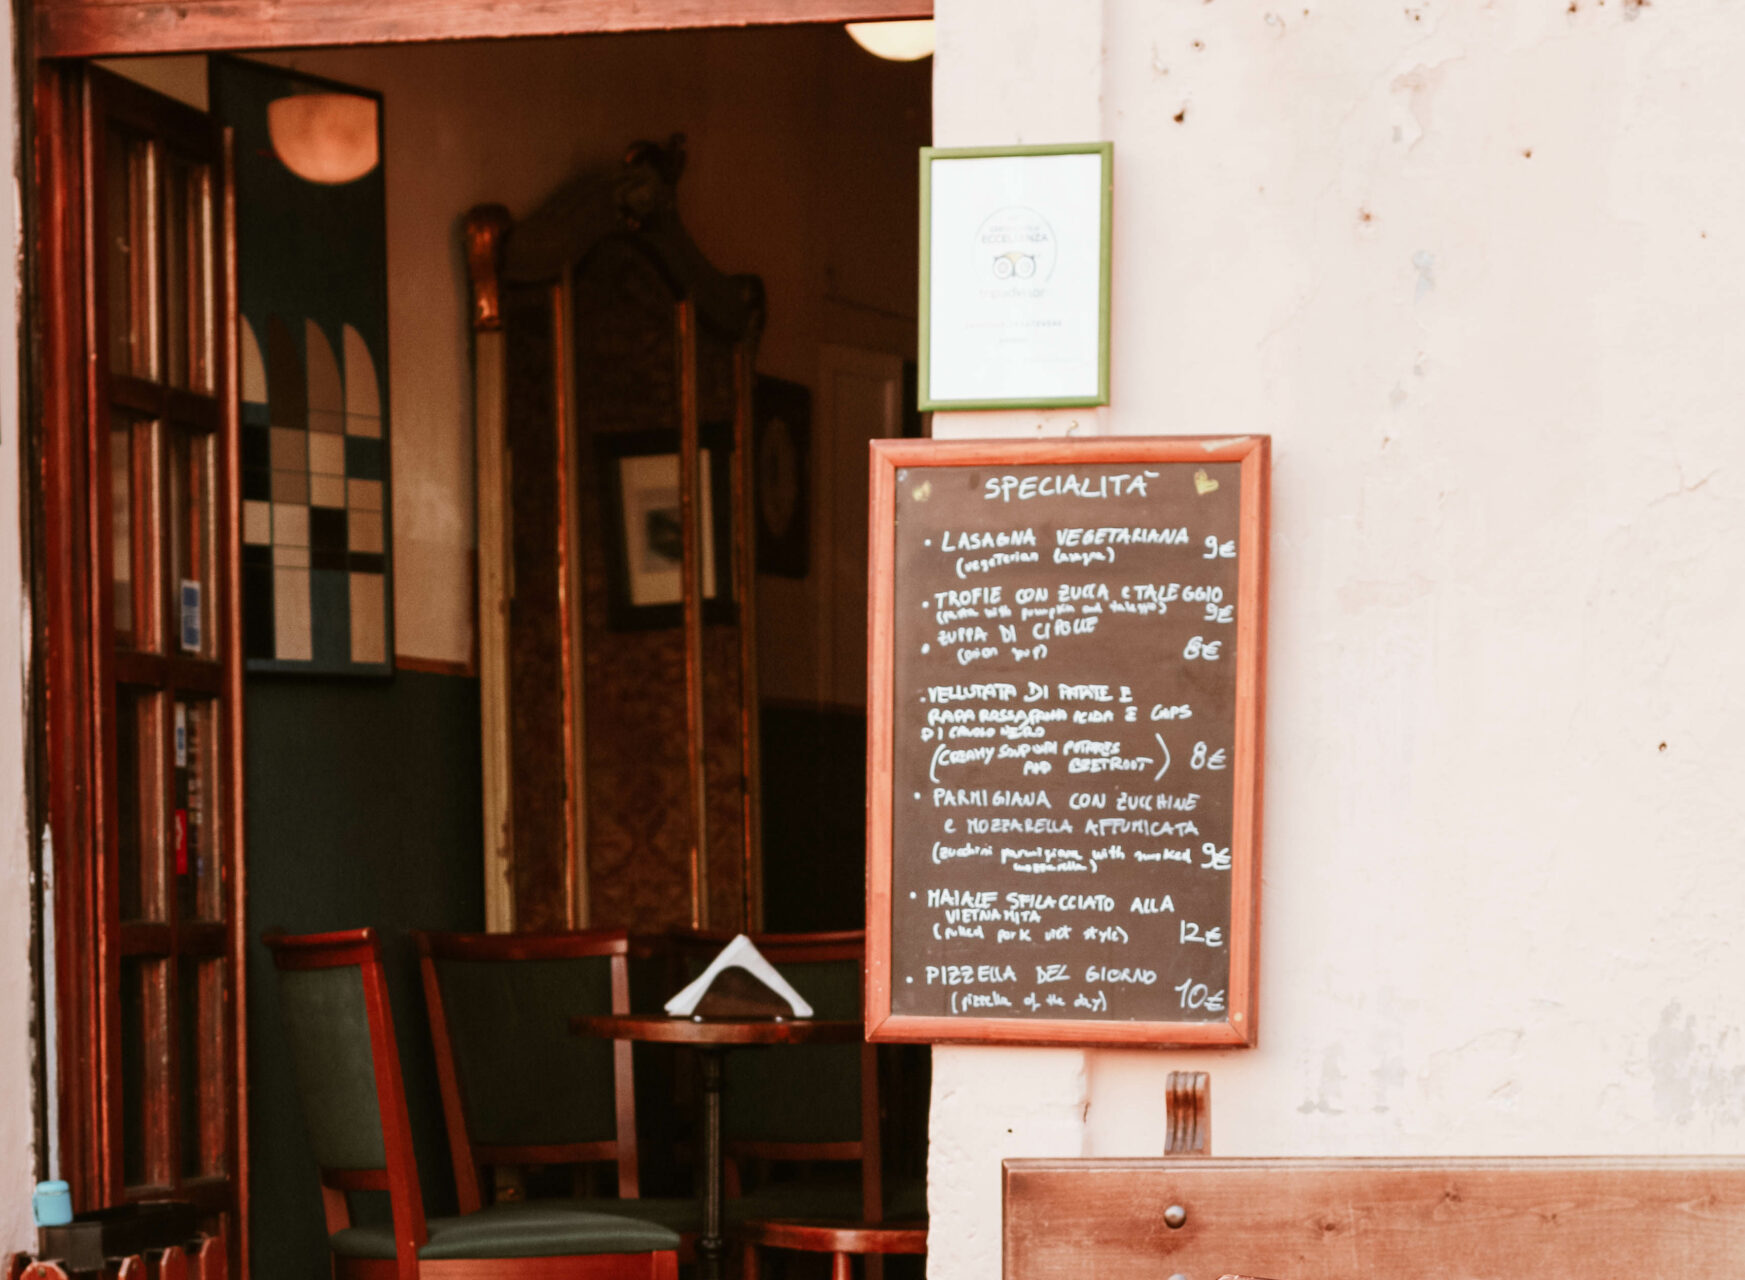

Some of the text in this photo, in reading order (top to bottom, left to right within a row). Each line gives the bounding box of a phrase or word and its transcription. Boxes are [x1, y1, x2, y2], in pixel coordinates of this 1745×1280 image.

[941, 527, 1236, 559] LASAGNA VEGETARIANA 9€
[934, 586, 1002, 609] TROFIE
[1015, 588, 1048, 604] CON
[1058, 583, 1109, 602] ZUCCA
[1204, 604, 1234, 623] 9€
[937, 628, 988, 647] ZUPPA
[998, 624, 1017, 643] DI
[928, 683, 1017, 703] VELLUTATA
[1023, 681, 1049, 703] DI
[1058, 683, 1113, 702] PATATE
[927, 708, 975, 726] RAPA
[1190, 741, 1227, 770] 8€
[932, 788, 1200, 812] PARMIGIANA CON ZUCCHINE
[966, 817, 1073, 835] MOZZARELLA
[1084, 818, 1199, 836] AFFUMICATA
[1091, 845, 1126, 860] with
[1200, 842, 1232, 870] 9€
[927, 889, 1175, 914] MAIALE SFILACCIATO ALLA
[945, 908, 1041, 925] VIETNAMITA
[997, 928, 1032, 943] pork
[1179, 919, 1224, 947] 12€
[925, 964, 1225, 1011] PIZZELLA DEL GIORNO 10€
[1023, 992, 1041, 1011] of
